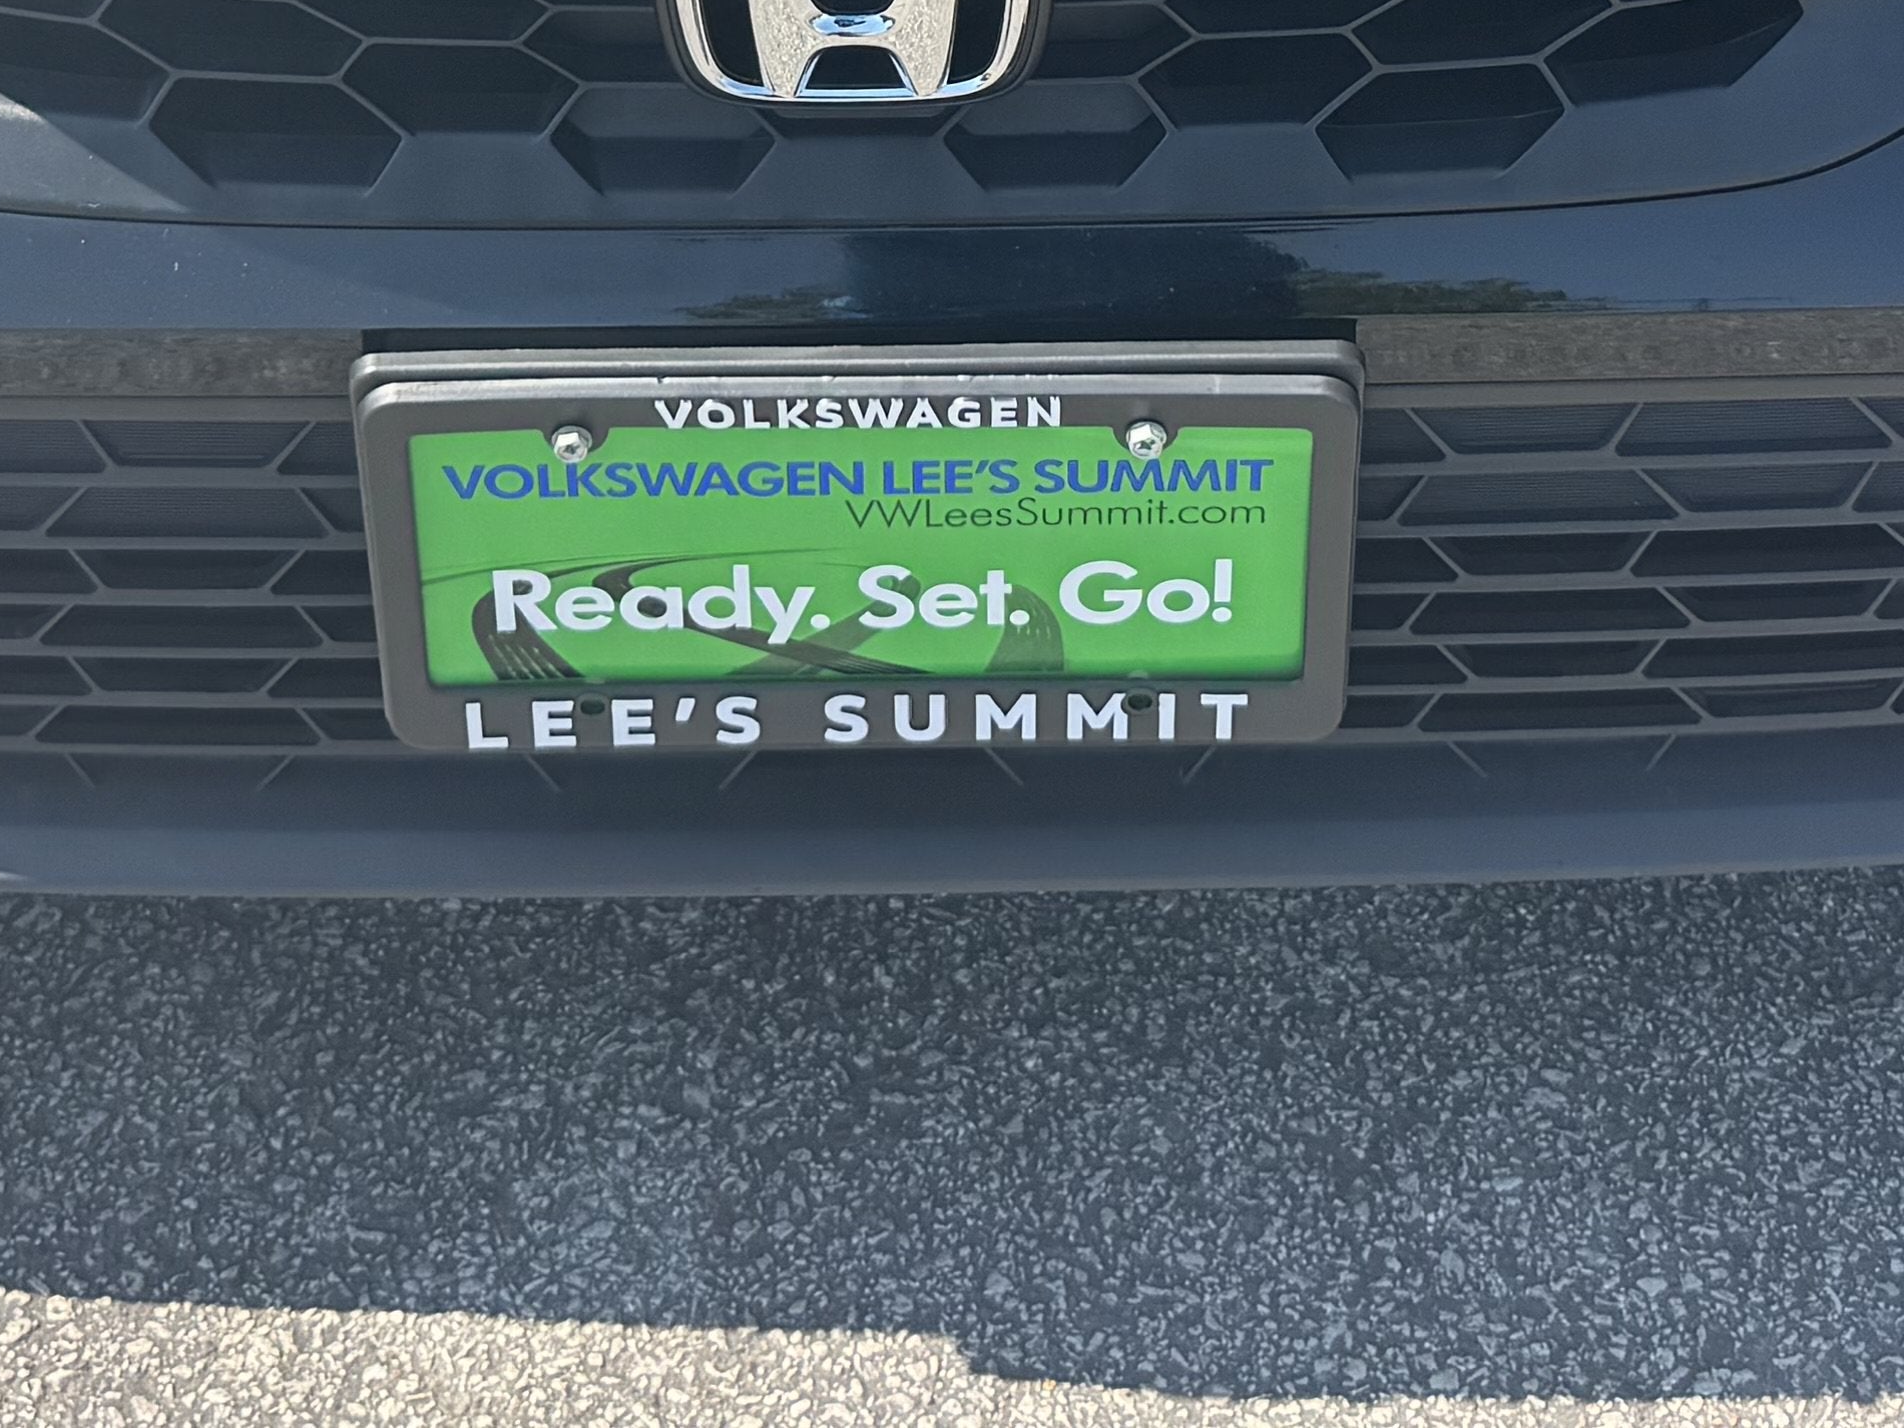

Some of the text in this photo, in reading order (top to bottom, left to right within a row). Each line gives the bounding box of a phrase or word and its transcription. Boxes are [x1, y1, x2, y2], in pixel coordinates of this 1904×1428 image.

[654, 396, 1061, 430] VOLKSWAGEN
[442, 458, 1274, 500] VOLKSWAGEN LEE'S SUMMIT
[845, 497, 1266, 529] VWLeesSummit.com
[492, 558, 1234, 645] Ready. Set. Go!
[465, 692, 1249, 749] LEE'S SUMMIT
